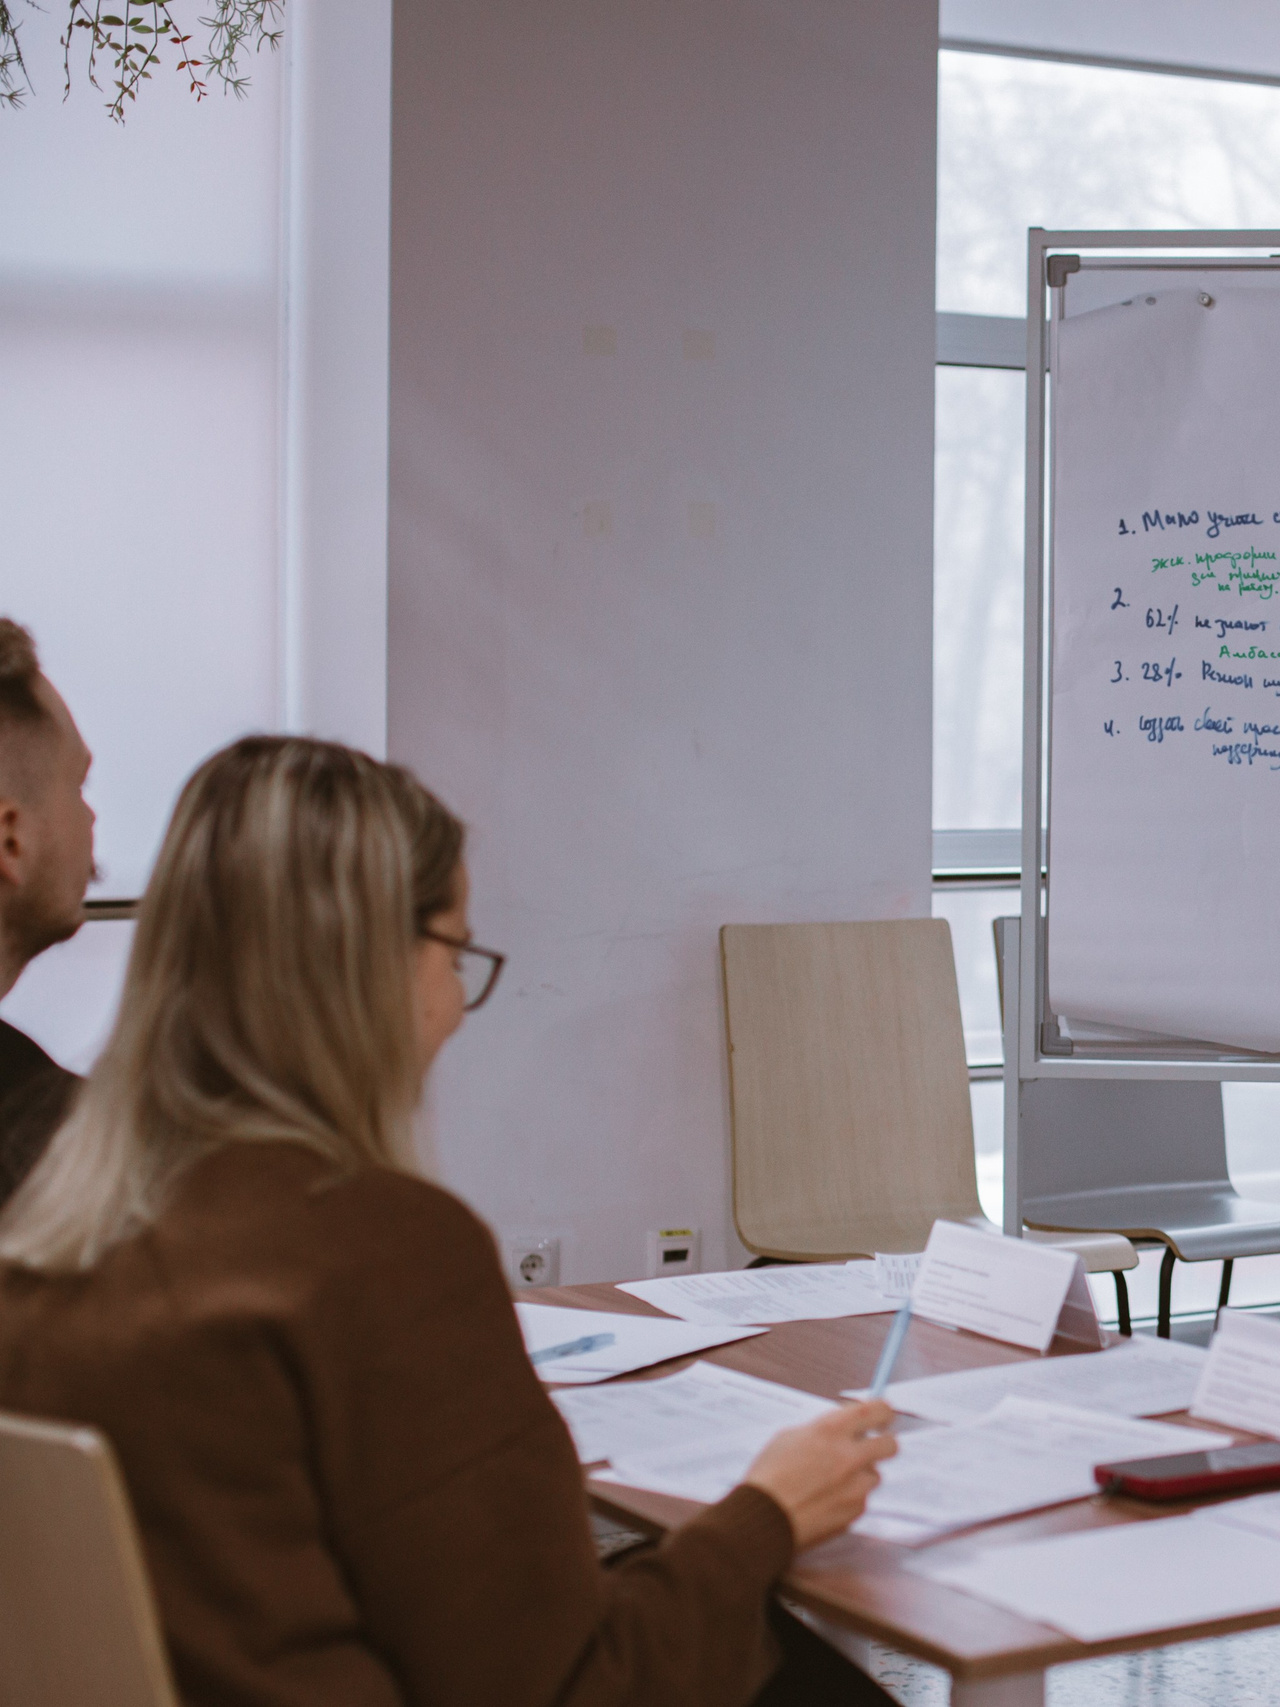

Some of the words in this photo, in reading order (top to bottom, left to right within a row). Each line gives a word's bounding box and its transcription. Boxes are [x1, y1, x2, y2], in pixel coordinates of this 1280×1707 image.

[1146, 604, 1179, 635] 62%
[1195, 616, 1211, 628] не
[1141, 657, 1182, 687] 28%
